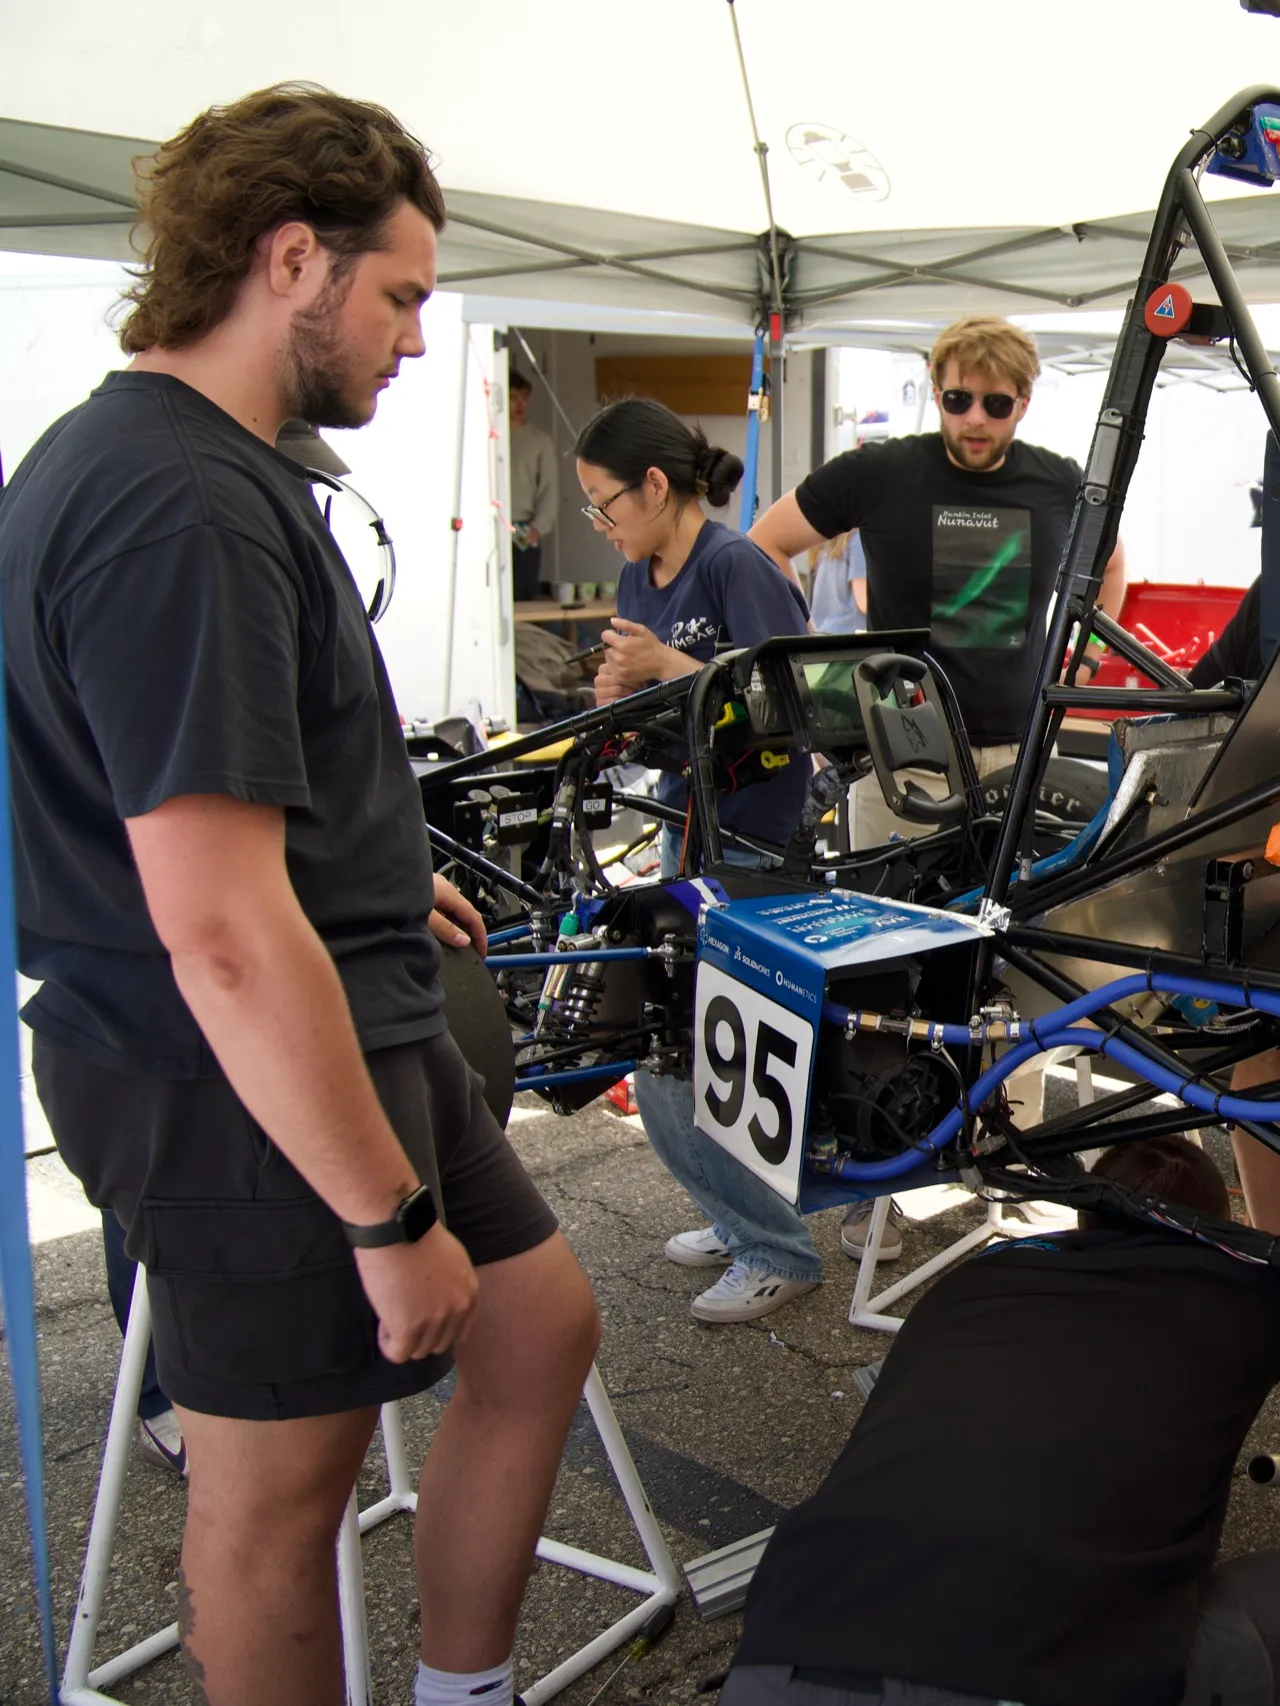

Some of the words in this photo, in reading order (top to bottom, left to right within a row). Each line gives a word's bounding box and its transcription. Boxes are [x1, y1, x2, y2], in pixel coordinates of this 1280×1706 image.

[937, 514, 999, 528] Nunavut
[943, 510, 971, 518] Rankin
[585, 800, 600, 810] GO
[504, 811, 532, 824] STOP
[708, 935, 730, 954] HEXAGON
[742, 956, 771, 977] SOLIDWORKS
[783, 978, 817, 1004] HUMANETICS
[704, 994, 798, 1166] 95
